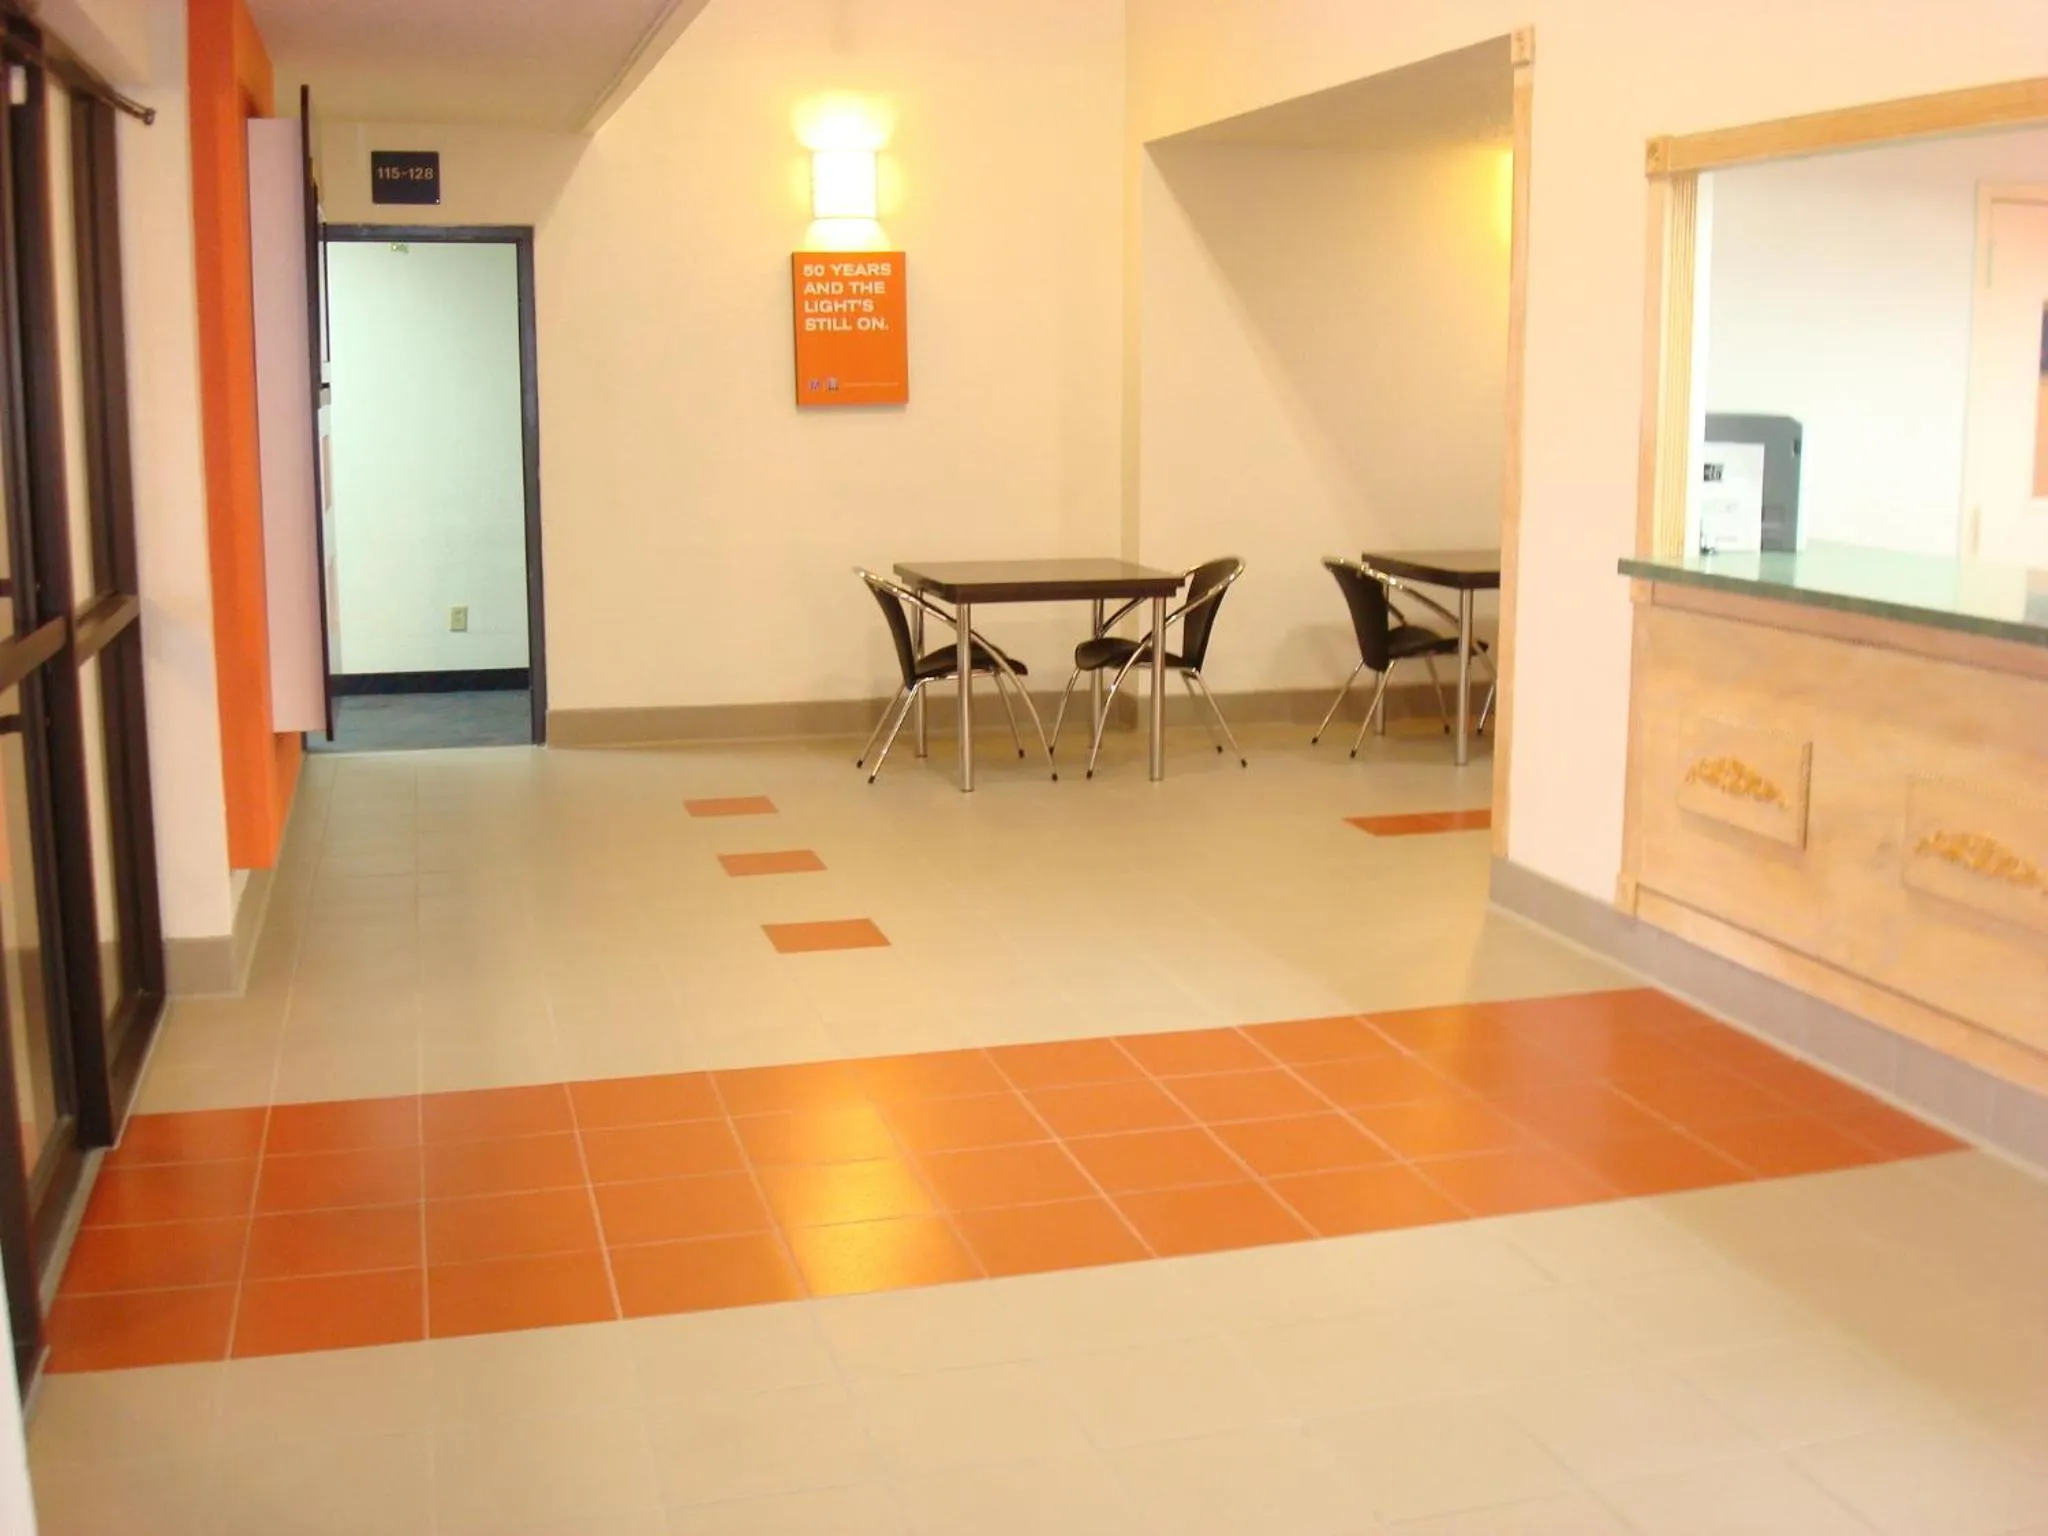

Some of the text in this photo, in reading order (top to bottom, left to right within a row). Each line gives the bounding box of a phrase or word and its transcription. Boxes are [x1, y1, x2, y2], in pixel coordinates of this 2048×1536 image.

[378, 166, 434, 180] 115-128
[803, 262, 892, 277] 50 YEARS
[803, 281, 886, 295] AND THE
[804, 299, 874, 313] LIGHT'S
[805, 316, 889, 332] STILL ON.
